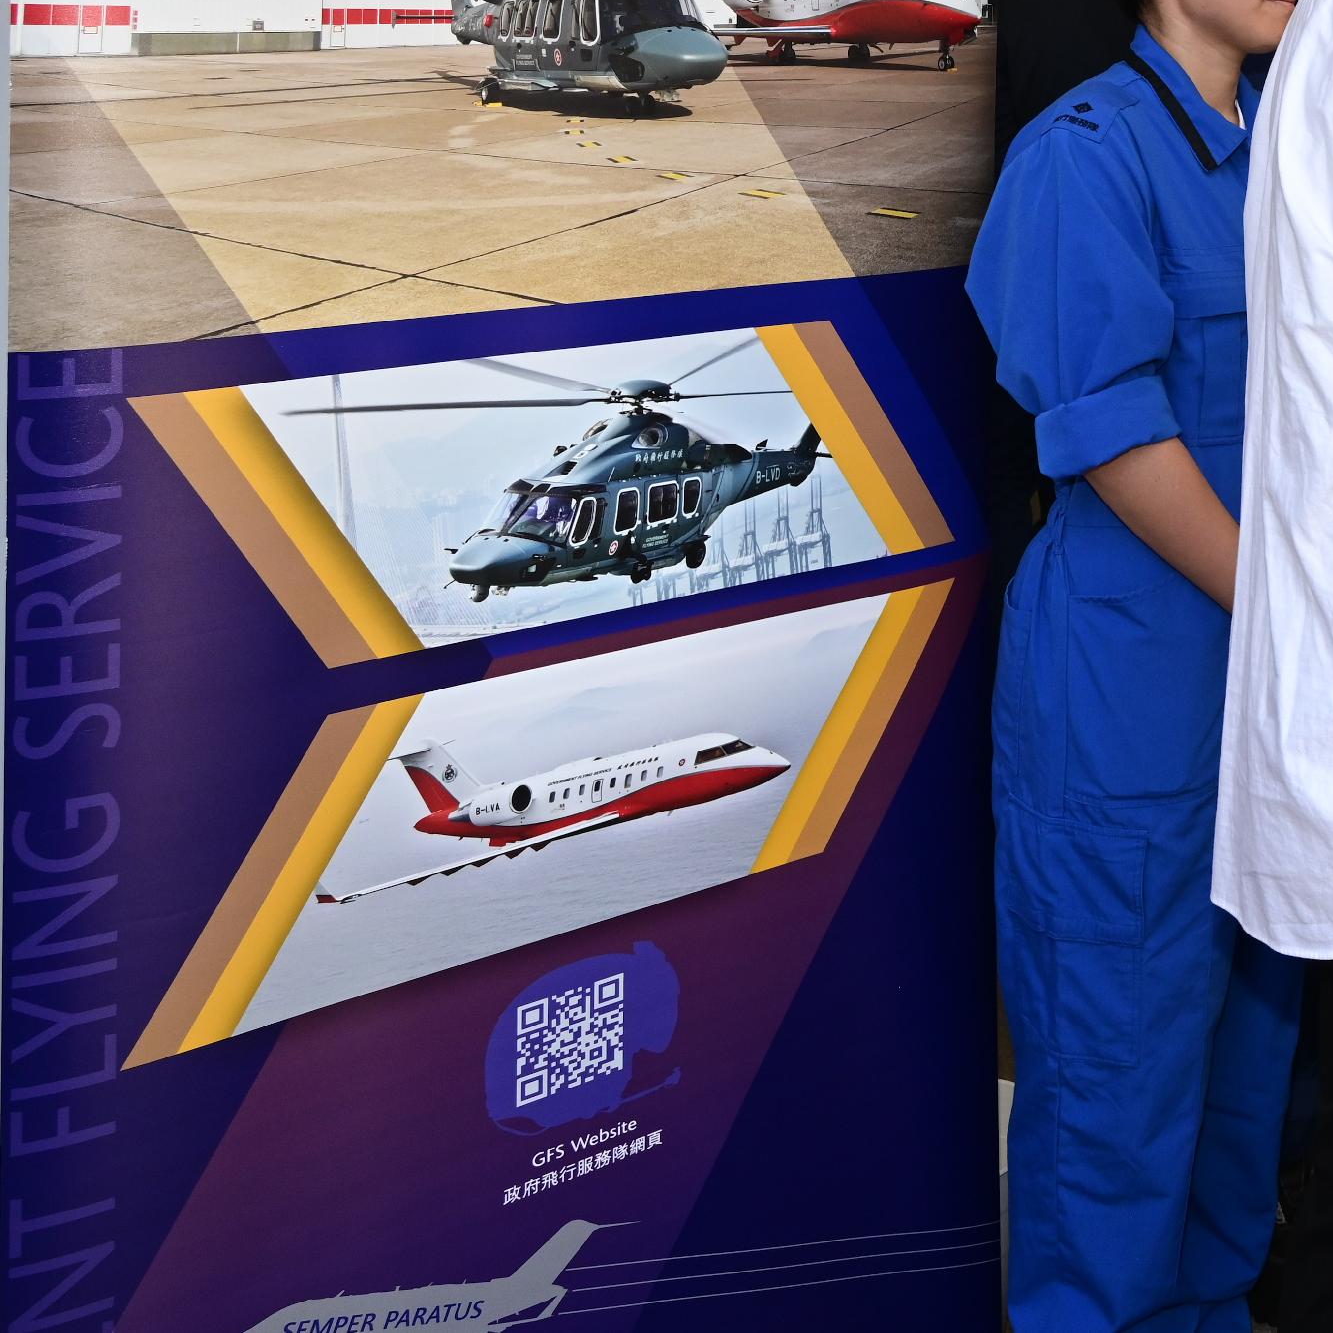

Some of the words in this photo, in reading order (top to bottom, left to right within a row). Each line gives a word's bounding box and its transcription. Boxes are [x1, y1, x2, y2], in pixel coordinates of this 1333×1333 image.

[755, 467, 781, 485] B-LVD
[12, 347, 125, 761] SERVICE
[475, 802, 501, 816] B-LVA
[10, 791, 121, 1157] FLYING
[532, 1143, 565, 1167] GFS
[571, 1119, 638, 1153] Website
[503, 1129, 663, 1206] 政府飛行服務隊網頁
[383, 1300, 485, 1330] PARATUS
